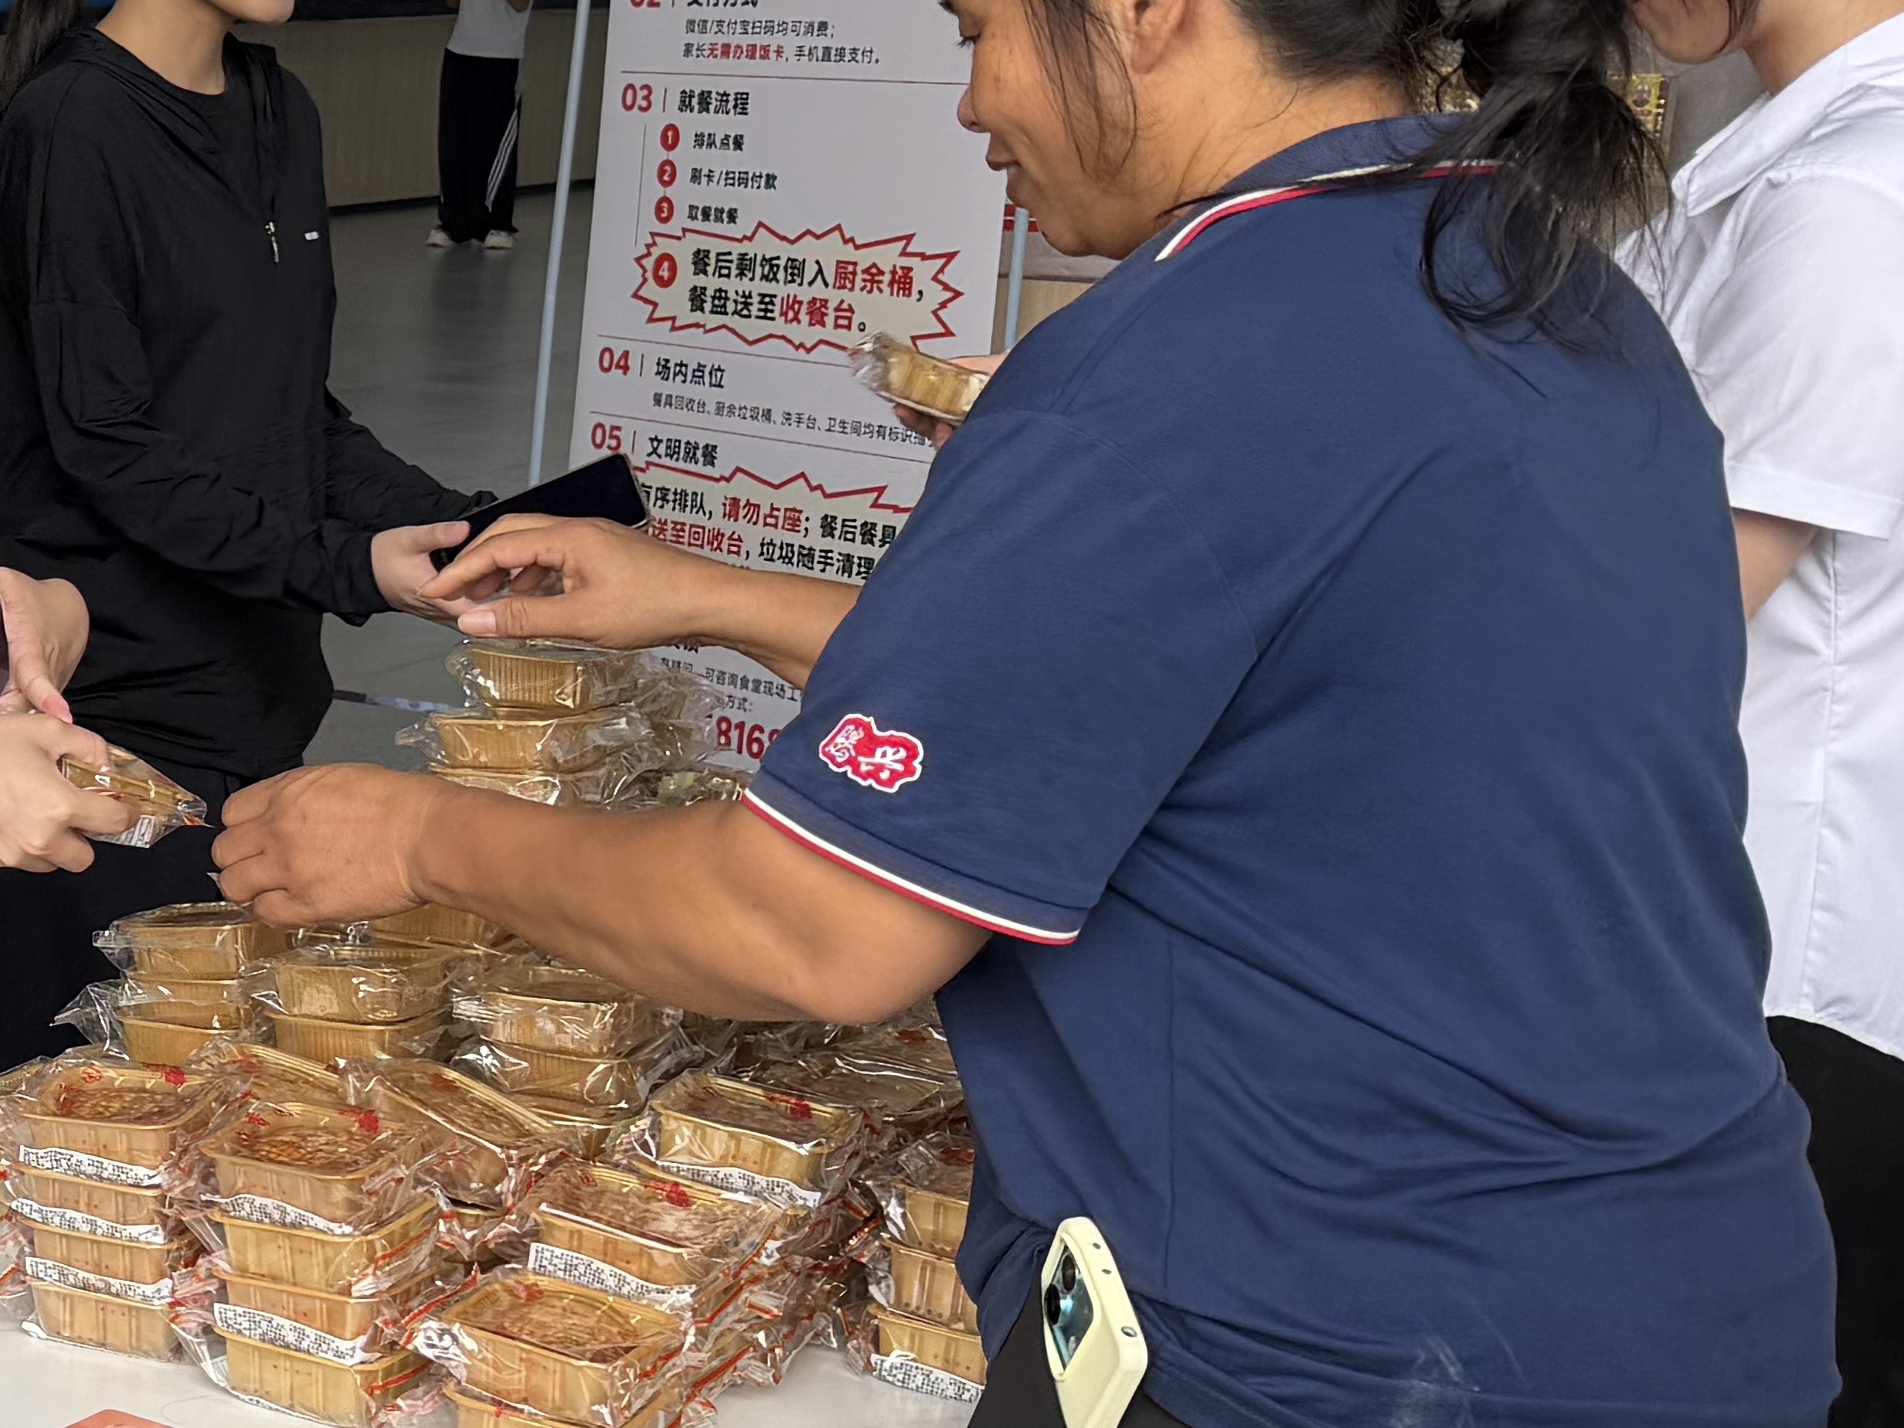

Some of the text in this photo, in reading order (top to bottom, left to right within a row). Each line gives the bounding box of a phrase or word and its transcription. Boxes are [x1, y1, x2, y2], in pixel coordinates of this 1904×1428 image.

[621, 83, 750, 117] 03 就餐流程
[693, 131, 745, 153] 排队点餐
[689, 168, 778, 191] 刷卡/扫码付款
[687, 204, 739, 225] 取餐就餐
[691, 248, 928, 304] 餐后剩饭倒入厨余桶，
[688, 285, 868, 334] 餐盘送至收餐台。
[598, 347, 726, 390] 04 场内点位
[591, 422, 719, 469] 05 文明就餐
[647, 517, 876, 581] 送至回收台，垃圾随手清理
[716, 715, 781, 760] 816
